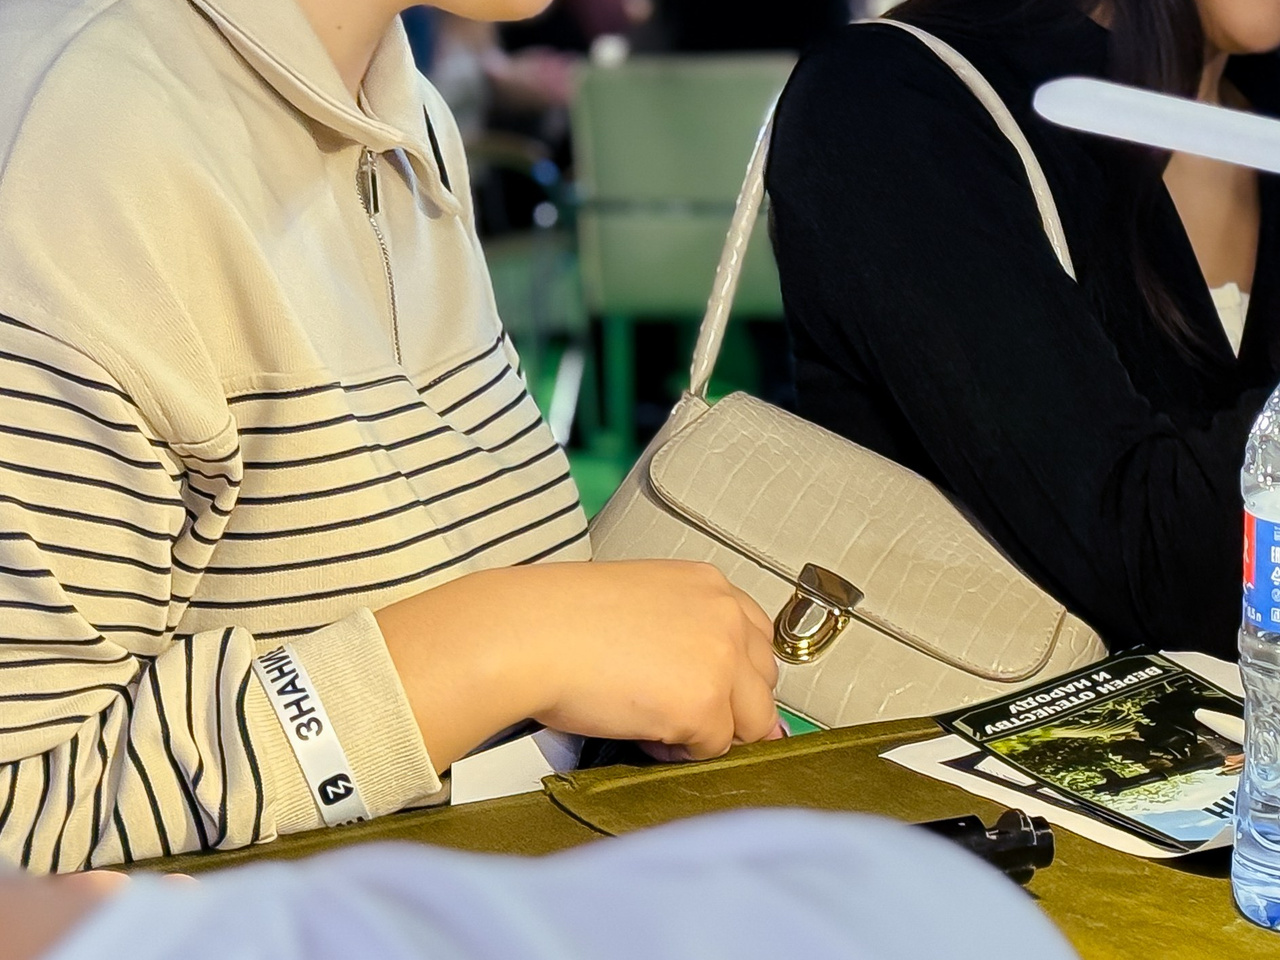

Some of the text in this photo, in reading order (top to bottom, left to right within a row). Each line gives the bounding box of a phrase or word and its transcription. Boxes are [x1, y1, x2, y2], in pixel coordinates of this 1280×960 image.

[984, 666, 1164, 735] ВЕРЕН ОТЕЧЕСТВУ
[1008, 671, 1112, 714] И НАРОДУ
